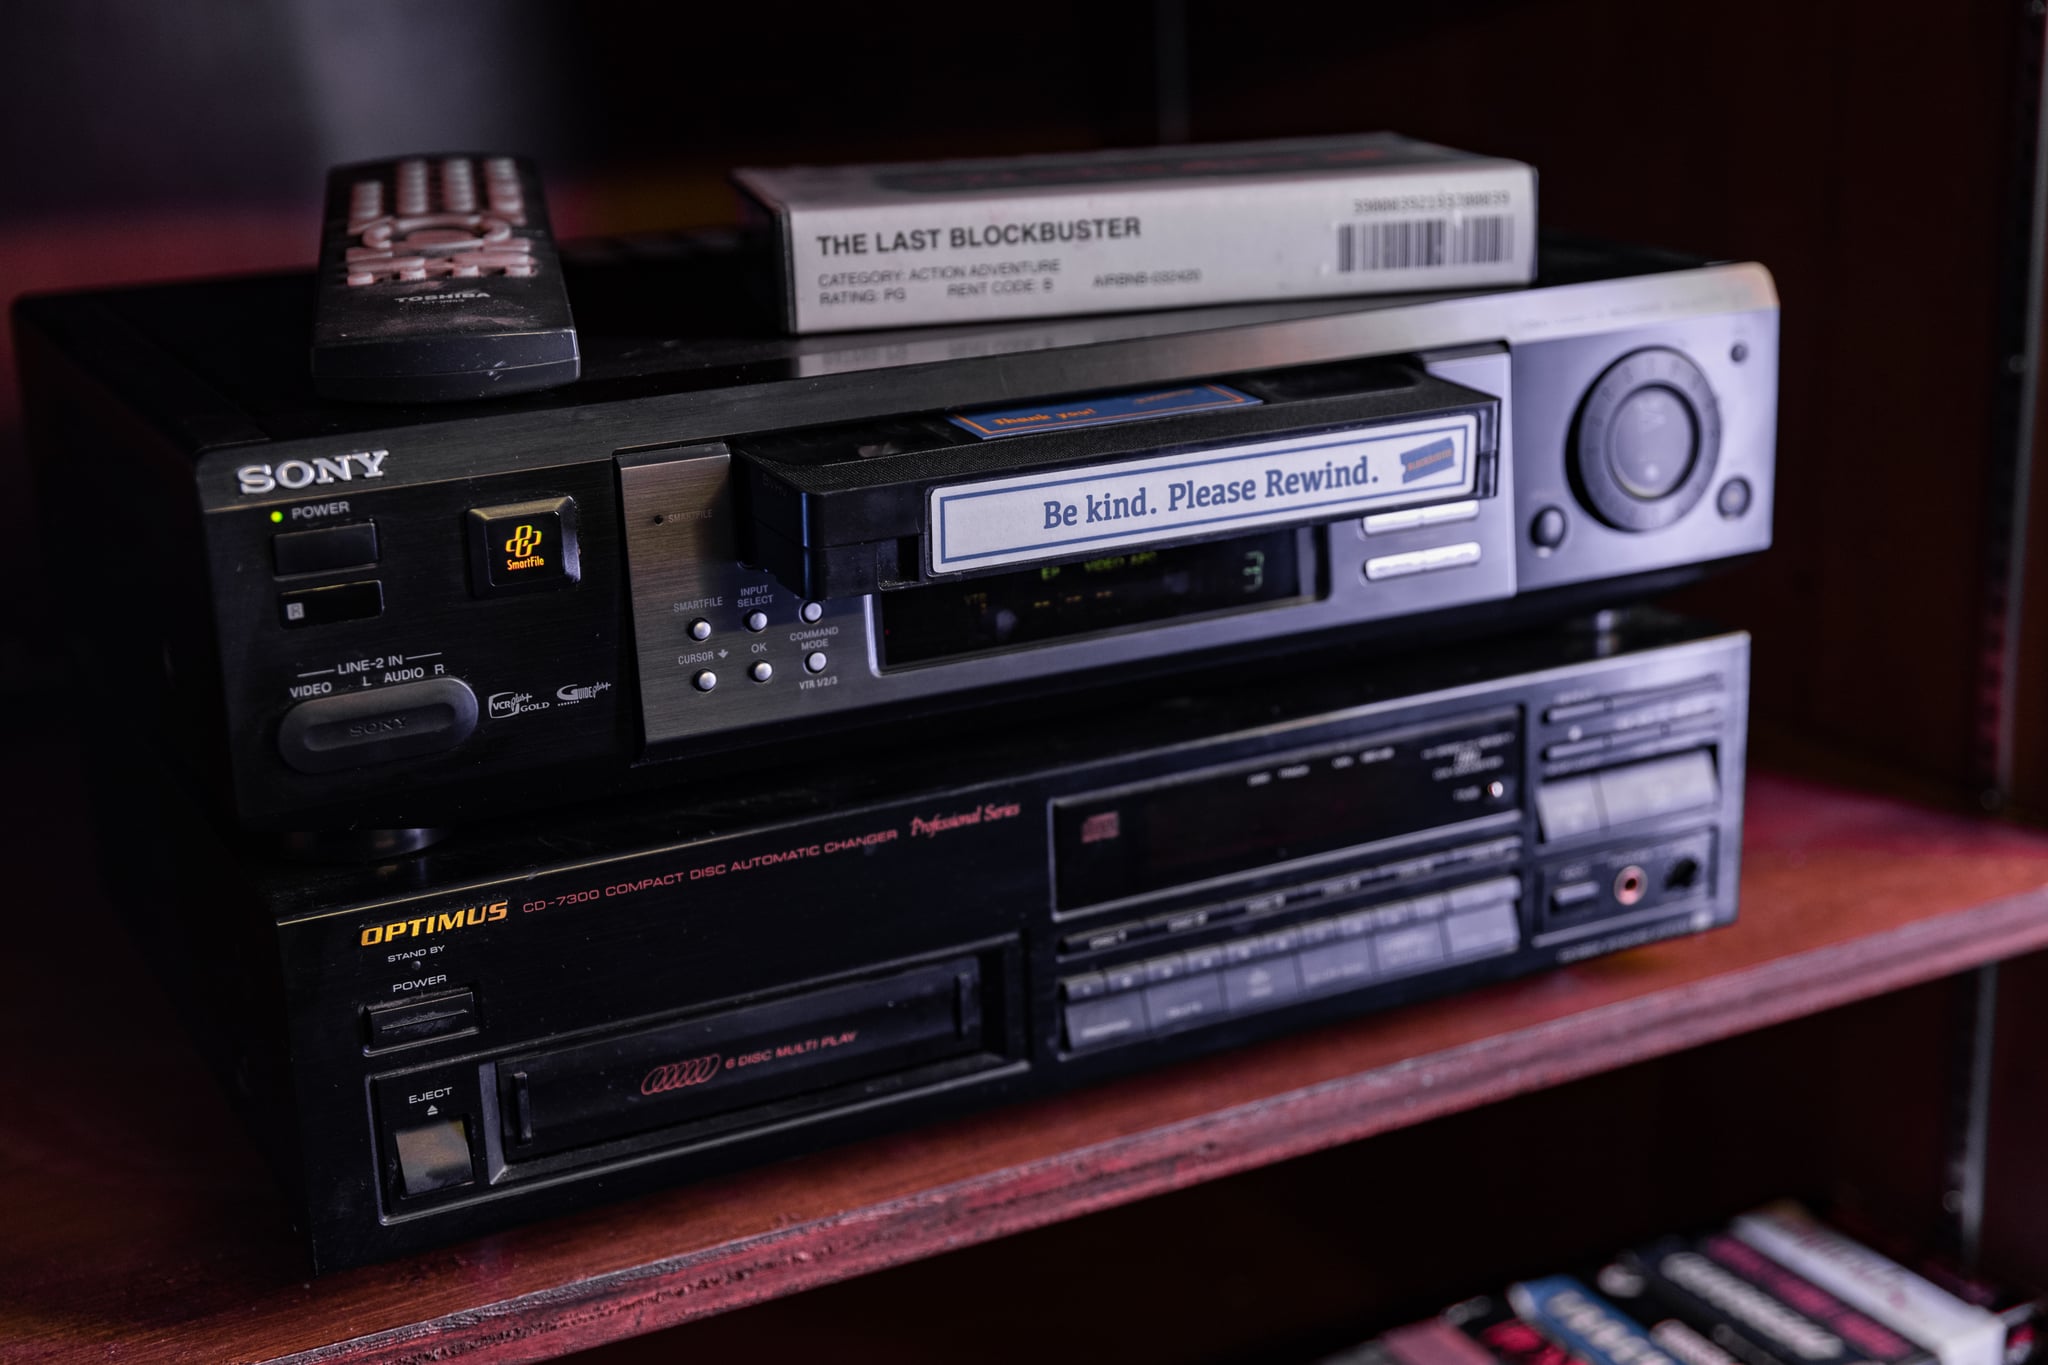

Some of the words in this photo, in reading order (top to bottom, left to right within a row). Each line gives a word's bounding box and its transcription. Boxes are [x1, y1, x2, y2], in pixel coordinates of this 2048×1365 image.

[817, 233, 867, 257] THE
[876, 229, 942, 253] LAST
[950, 217, 1142, 249] BLOCKBUSTER
[818, 269, 905, 288] CATEGORY:
[908, 265, 967, 282] ACTION
[969, 259, 1061, 280] ADVENTURE
[394, 292, 491, 302] TOSHIBA
[819, 290, 880, 307] RATING:
[884, 288, 906, 303] PG
[947, 281, 987, 298] RENT
[992, 413, 1051, 426] Thank
[1056, 407, 1096, 421] you!
[237, 450, 390, 494] SONY
[1043, 501, 1077, 530] Be
[1086, 489, 1157, 524] kind.
[1168, 479, 1257, 512] Please
[1264, 456, 1379, 498] Rewind.
[291, 501, 350, 520] POWER
[668, 509, 713, 523] SMARTFILE
[507, 555, 545, 571] SmartFile
[740, 584, 769, 597] INPUT
[673, 596, 723, 613] SMARTFILE
[737, 594, 774, 608] SELECT
[790, 626, 839, 641] COMMAND
[751, 642, 767, 653] OK
[801, 638, 829, 650] MODE
[337, 657, 385, 676] LINE-2
[388, 654, 404, 667] IN
[678, 651, 714, 665] CURSOR
[384, 667, 425, 683] AUDIO
[434, 664, 445, 675] R
[290, 681, 332, 699] VIDEO
[362, 675, 372, 688] L
[799, 678, 816, 690] VTR
[817, 676, 838, 687] 1/2/3
[520, 702, 550, 713] GOLD
[350, 718, 408, 737] SONY
[910, 806, 981, 838] Professional
[984, 803, 1021, 822] Series
[523, 889, 600, 913] CD-7300
[605, 872, 685, 897] COMPACT
[690, 864, 726, 881] DISC
[731, 846, 820, 872] AUTOMATIC
[824, 829, 898, 853] CHANGER
[360, 901, 509, 946] OPTIMUS
[387, 948, 427, 963] STAND
[430, 945, 446, 954] BY
[392, 974, 448, 992] POWER
[738, 1049, 773, 1068] DISC
[776, 1040, 818, 1061] MULTI
[822, 1031, 858, 1051] PLAY
[408, 1086, 453, 1104] EJECT
